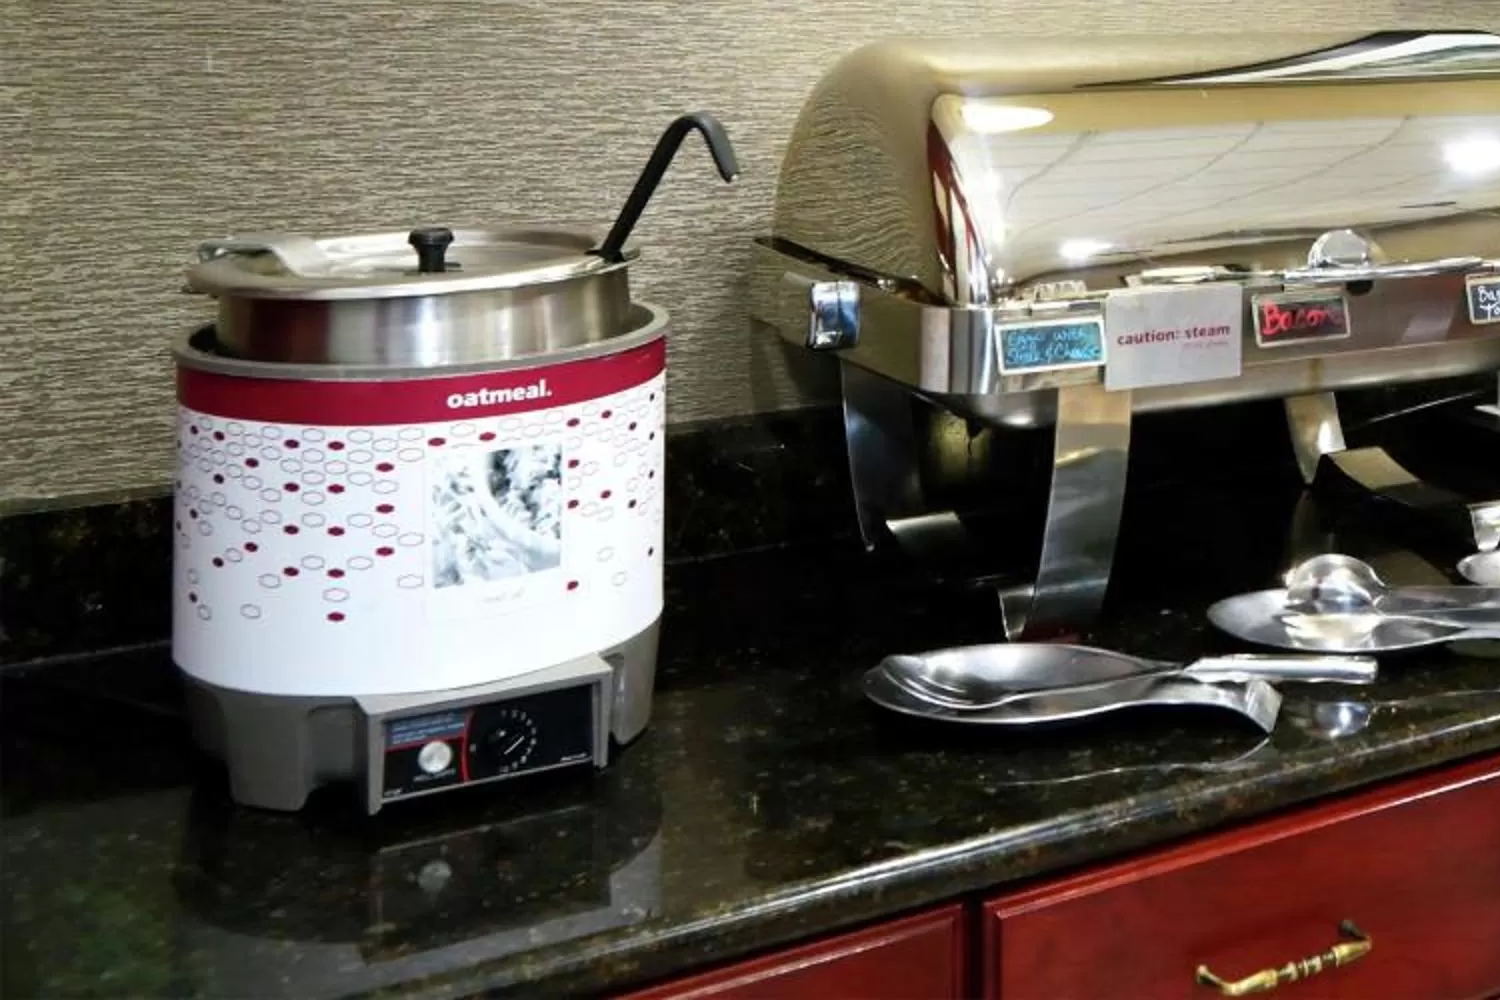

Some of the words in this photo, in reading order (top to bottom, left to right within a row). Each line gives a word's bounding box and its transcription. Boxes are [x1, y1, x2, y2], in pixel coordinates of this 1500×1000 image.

[1116, 328, 1182, 346] caution:
[1184, 324, 1231, 340] steam
[447, 378, 553, 410] oatmeal.
